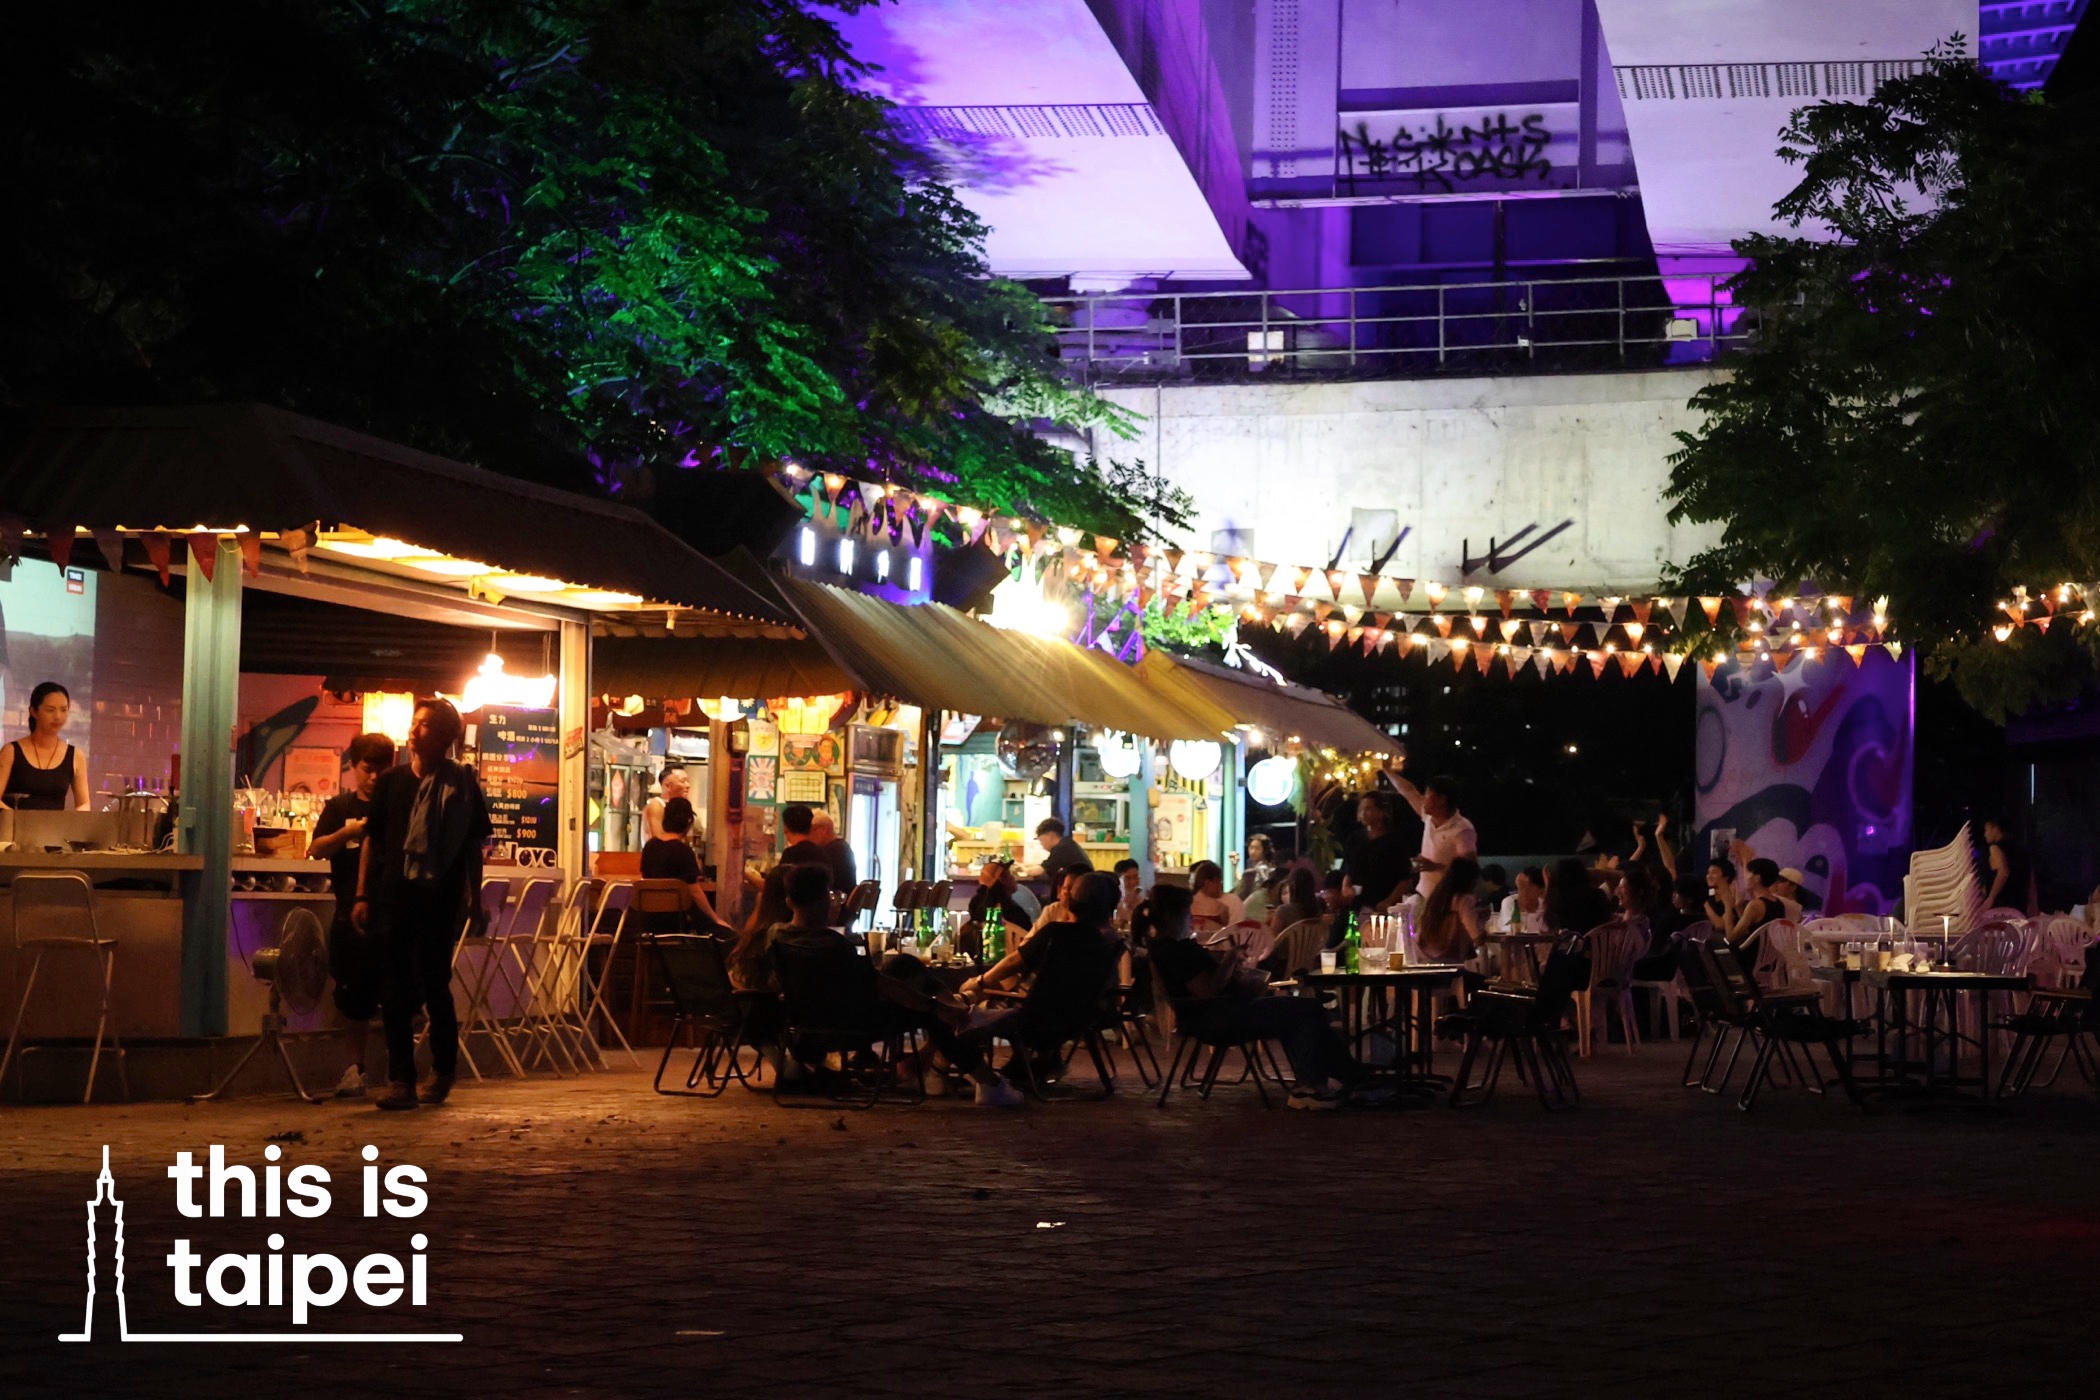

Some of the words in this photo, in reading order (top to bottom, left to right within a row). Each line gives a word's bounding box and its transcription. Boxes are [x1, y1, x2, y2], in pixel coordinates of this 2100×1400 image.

[488, 713, 507, 726] 生力
[506, 788, 527, 799] $800
[516, 828, 537, 839] $900
